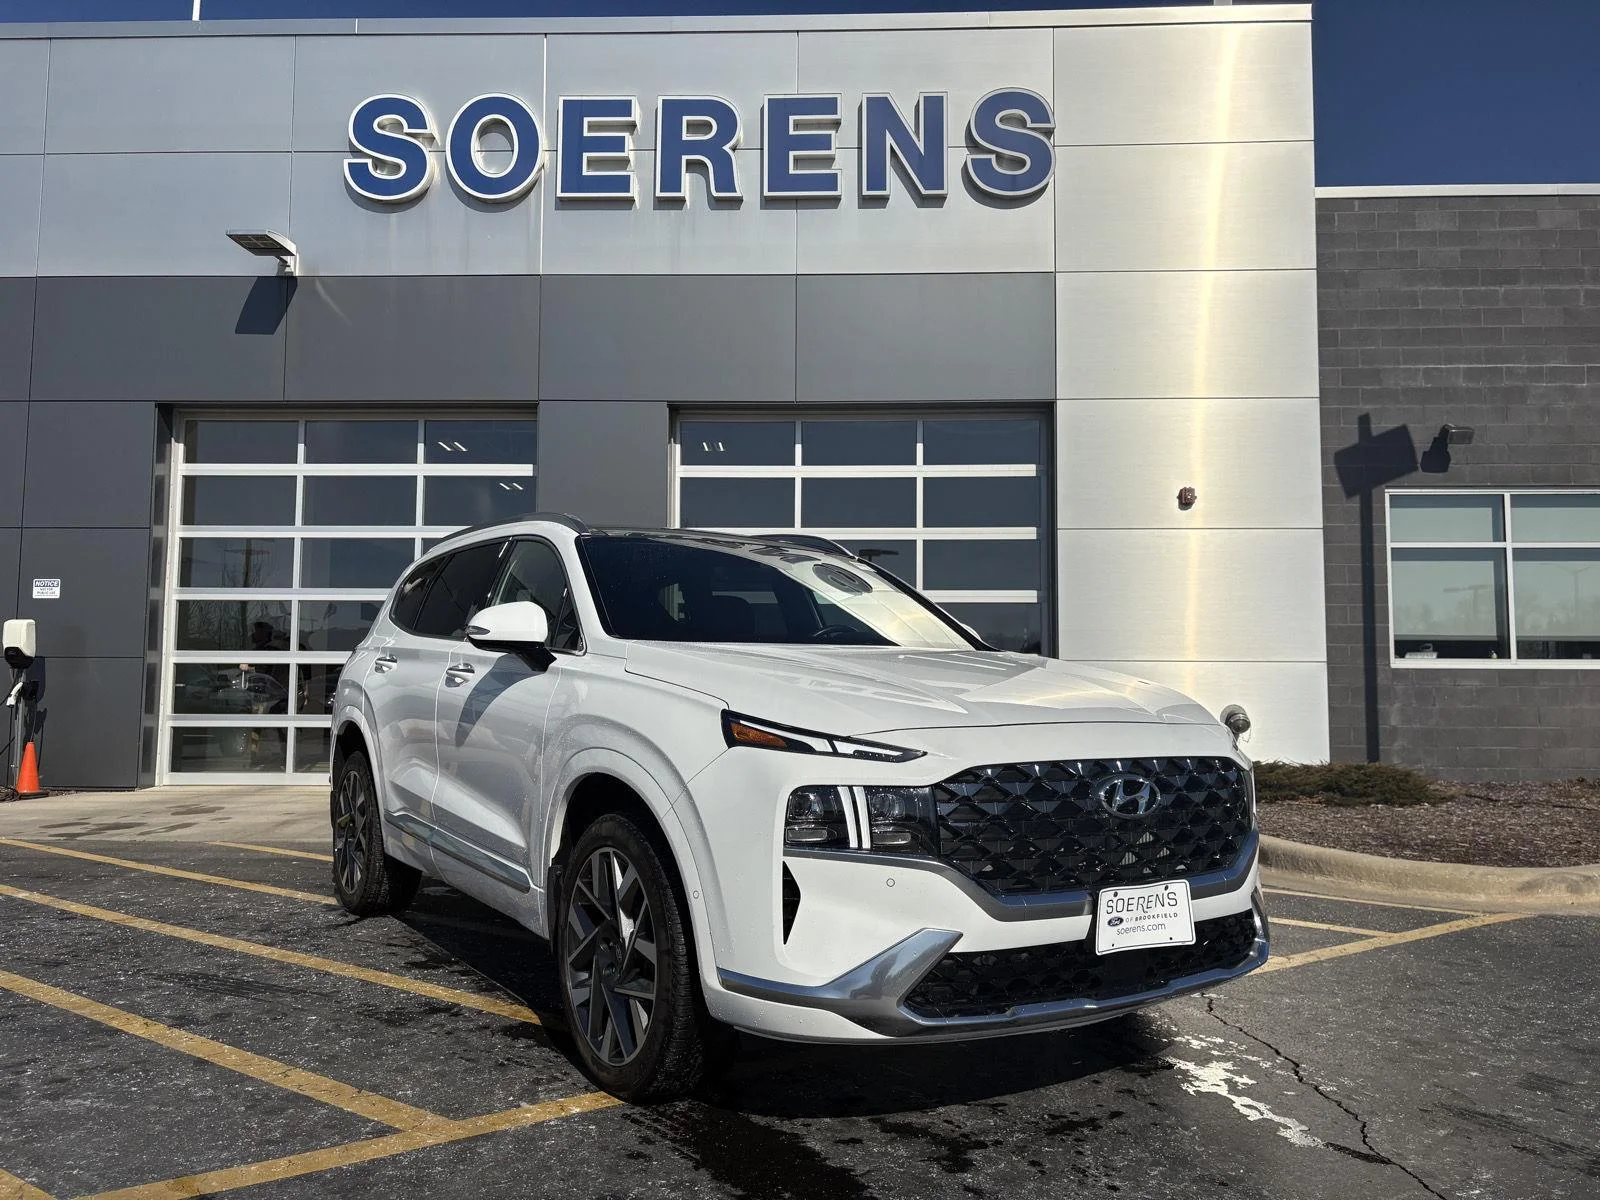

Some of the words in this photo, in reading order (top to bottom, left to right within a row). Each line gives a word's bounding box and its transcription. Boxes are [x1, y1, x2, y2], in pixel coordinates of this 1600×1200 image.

[343, 86, 1057, 203] SOERENS
[1106, 891, 1178, 915] SOERENS
[1134, 912, 1178, 922] BROOKFIELD
[1116, 922, 1167, 936] soerens.com
